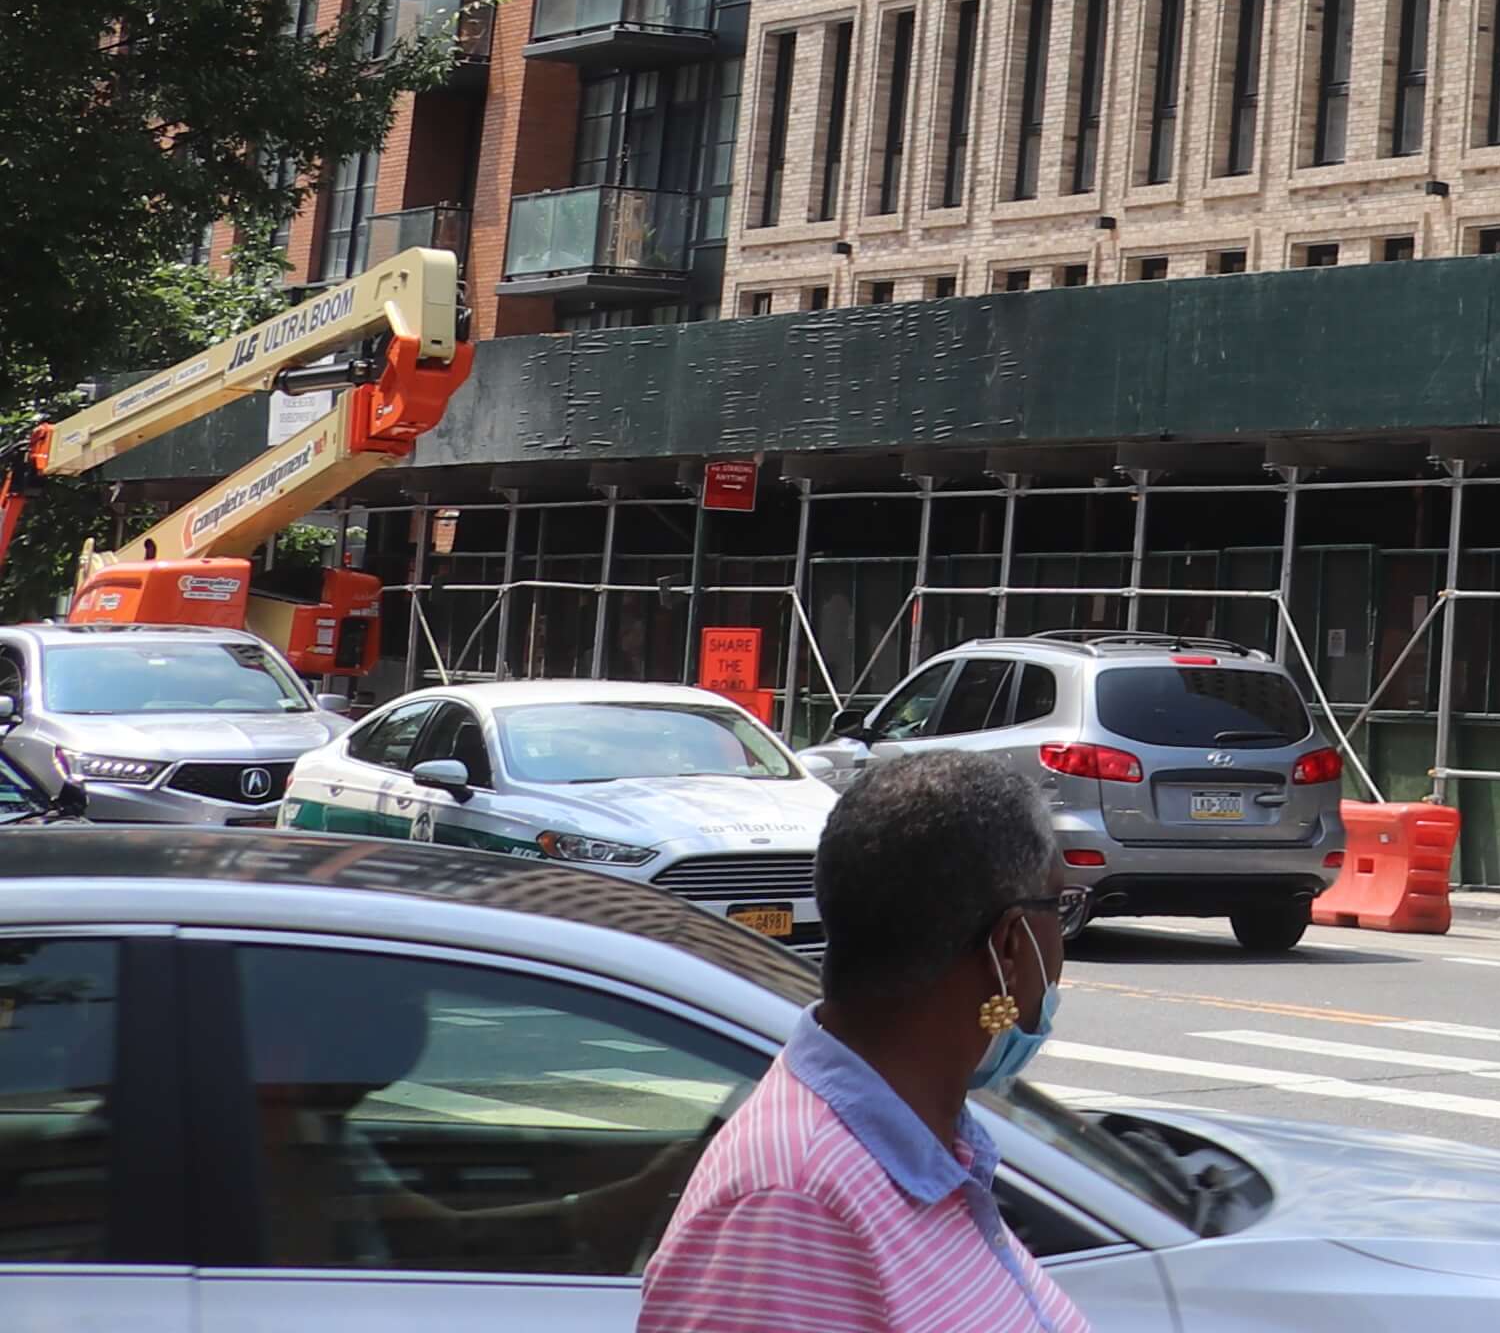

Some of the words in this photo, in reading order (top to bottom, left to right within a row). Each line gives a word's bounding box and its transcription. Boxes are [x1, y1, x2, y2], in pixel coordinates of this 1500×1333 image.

[227, 333, 260, 372] JLG
[263, 308, 309, 354] ULTRA
[309, 286, 356, 333] BOOM
[715, 474, 748, 483] ANYTIME
[193, 487, 248, 535] complete
[248, 445, 312, 503] equipment
[708, 638, 753, 654] SHARE
[717, 659, 742, 674] THE
